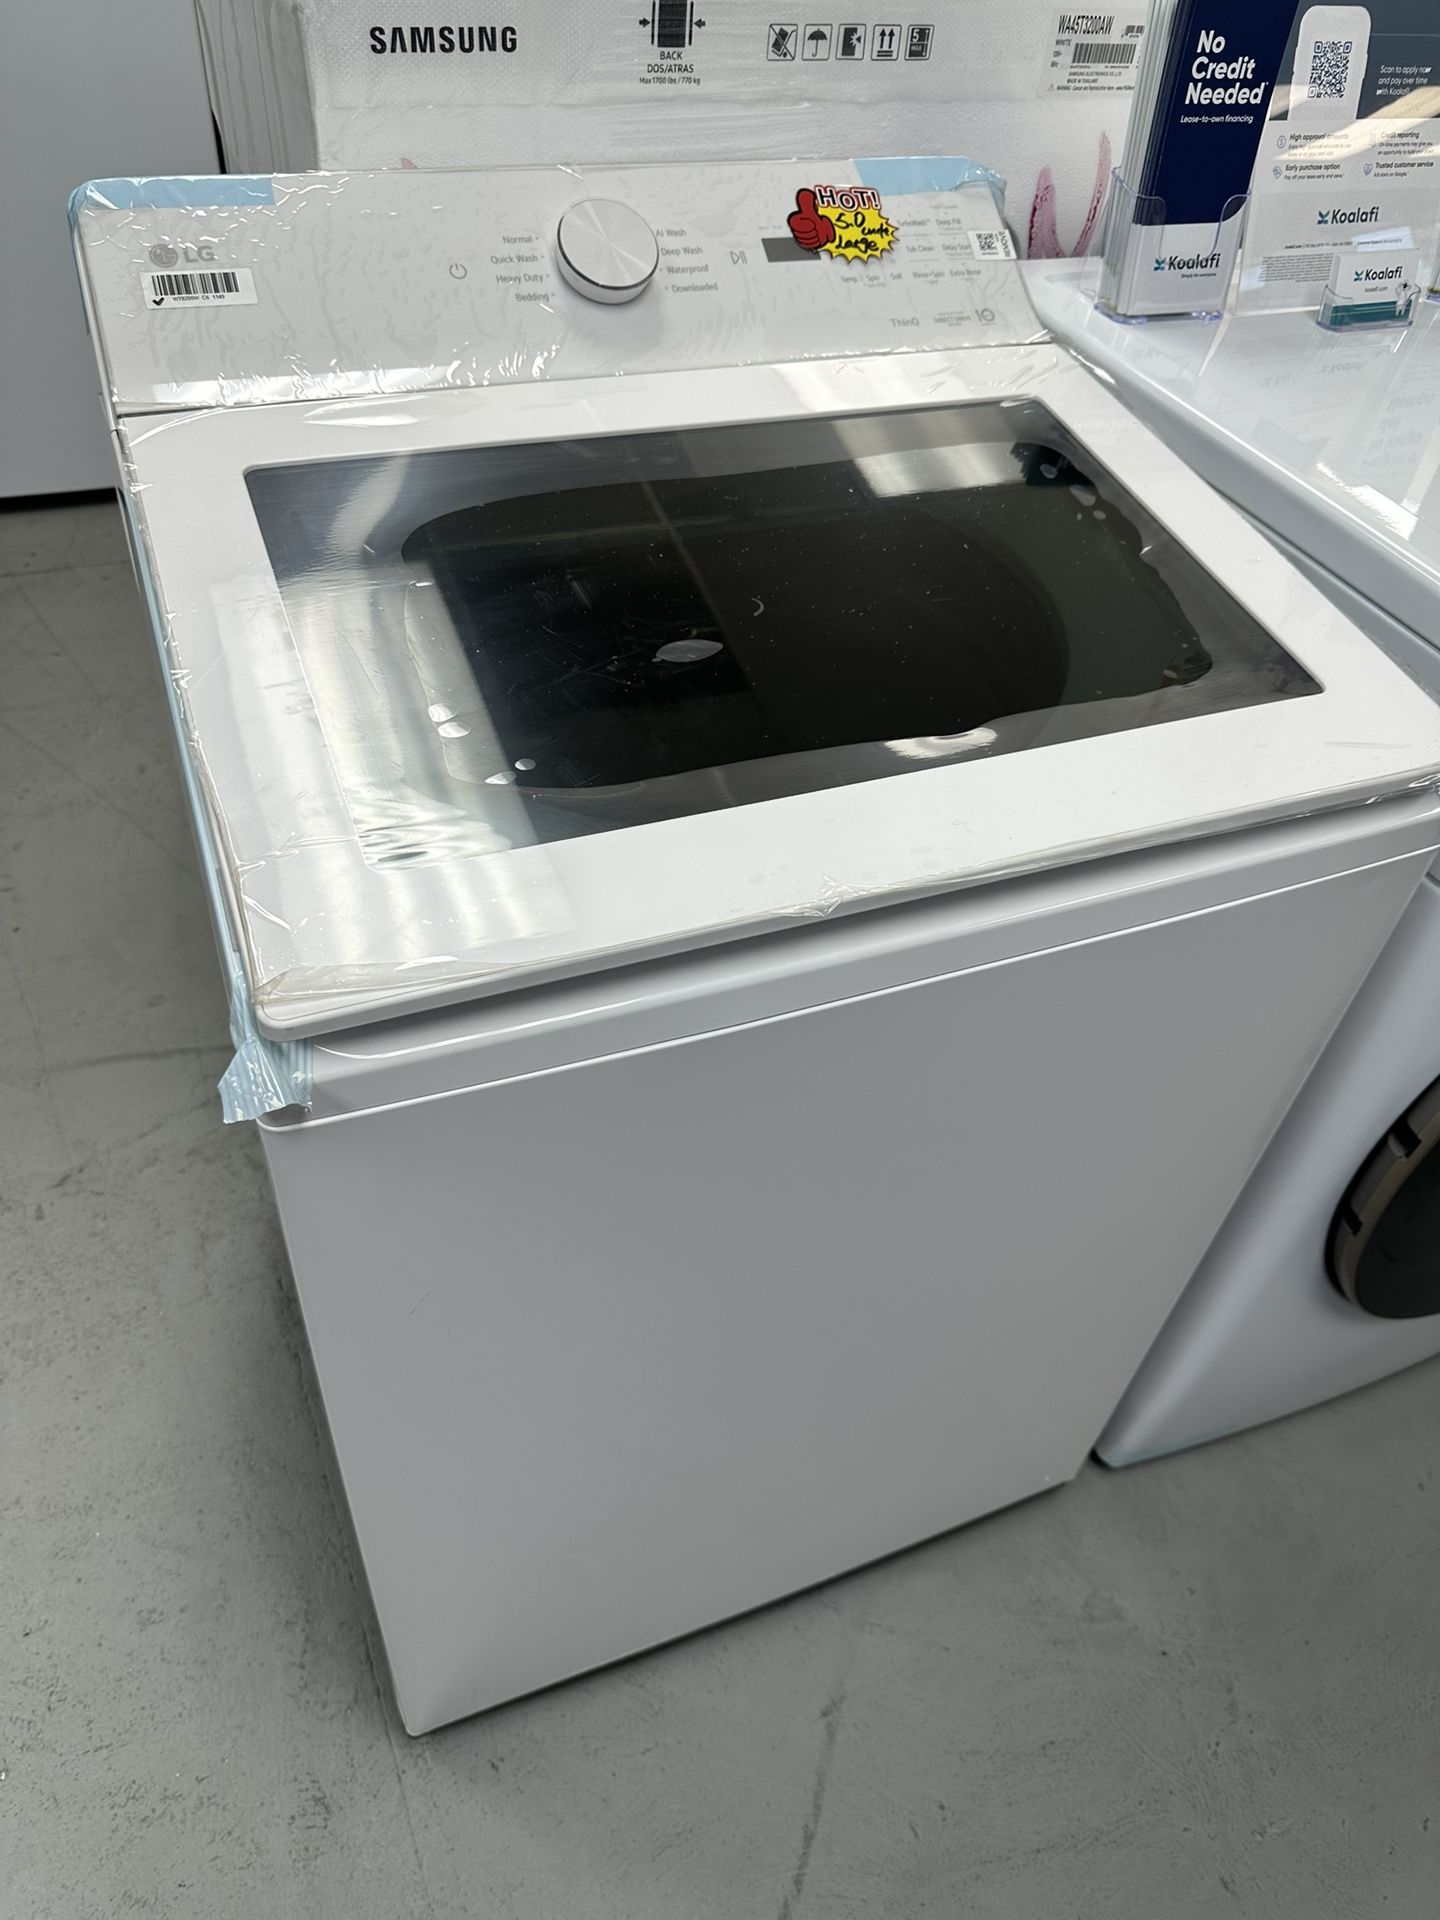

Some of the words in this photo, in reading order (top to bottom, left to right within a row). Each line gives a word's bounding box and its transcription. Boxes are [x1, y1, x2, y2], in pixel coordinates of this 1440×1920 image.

[369, 26, 518, 54] SAMSUNG
[912, 28, 920, 42] 5
[1196, 30, 1226, 54] No
[659, 51, 683, 61] BACK
[647, 63, 695, 74] DOS/ATRAS
[1191, 56, 1257, 80] Credit
[1380, 65, 1395, 74] Scan
[1402, 66, 1419, 75] apply
[1378, 77, 1391, 85] and
[1390, 78, 1402, 87] pay
[1180, 115, 1225, 124] Lease-to-own
[1225, 113, 1254, 125] financing
[1289, 132, 1302, 143] High
[1302, 132, 1327, 142] approval
[1397, 130, 1420, 140] reporting
[1285, 163, 1298, 173] Early
[1298, 164, 1323, 173] purchase
[1322, 162, 1341, 171] option
[1375, 161, 1394, 169] Trusted
[1394, 161, 1417, 169] customer
[1416, 160, 1434, 168] service
[817, 187, 880, 210] HOT!
[1330, 206, 1380, 225] Koalafi
[502, 234, 534, 244] Normal
[665, 228, 687, 238] Wash
[835, 234, 880, 254] Large
[183, 245, 217, 263] LG
[490, 254, 515, 265] Quick
[515, 253, 539, 263] Wash
[1168, 252, 1221, 271] Koalafi
[665, 263, 709, 276] Waterproof
[1364, 265, 1403, 282] Koalafi
[495, 274, 521, 285] Heavy
[523, 272, 544, 284] Duty
[671, 281, 719, 294] Downloaded
[514, 292, 550, 303] Bedding
